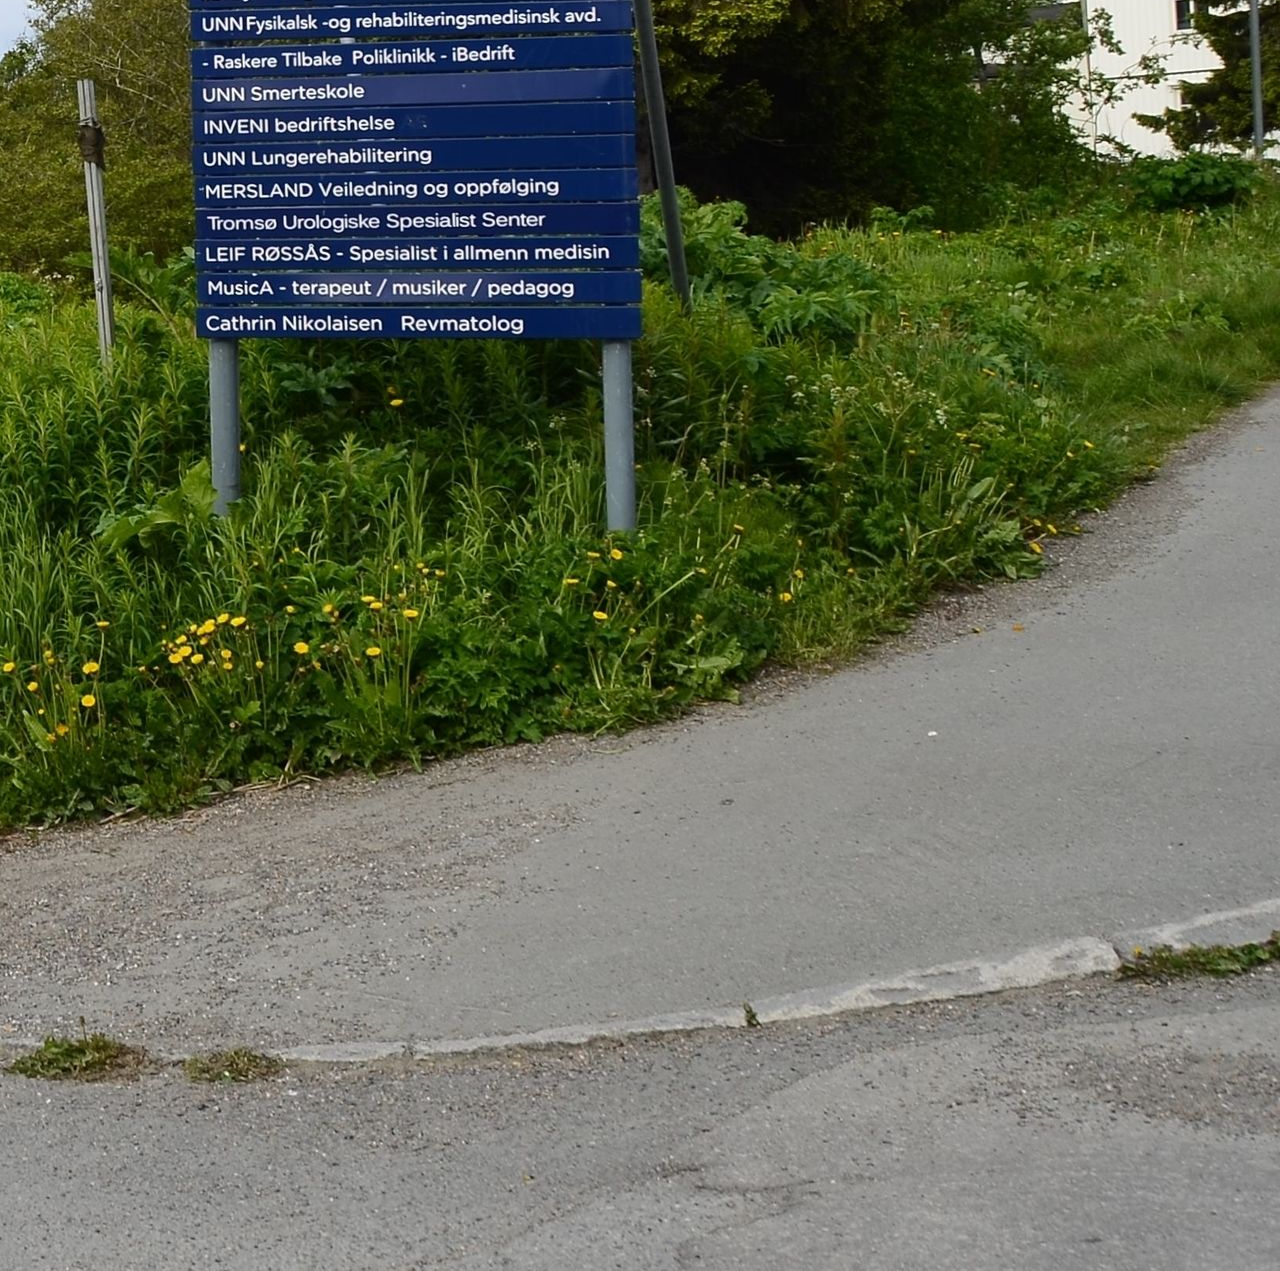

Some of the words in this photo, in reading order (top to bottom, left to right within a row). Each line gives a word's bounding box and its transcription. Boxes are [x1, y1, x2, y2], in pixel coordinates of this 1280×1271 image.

[203, 17, 243, 31] UNN
[247, 14, 317, 34] Fysikalsk
[323, 18, 350, 32] -og
[356, 8, 560, 29] rehabiliteringsmedisinsk
[565, 7, 601, 22] avd.
[214, 54, 277, 69] Raskere
[282, 51, 342, 66] Tilbake
[353, 48, 435, 64] Poliklinikk
[453, 45, 515, 61] iBedrift
[203, 87, 244, 102] UNN
[251, 84, 364, 101] Smerteskole
[204, 119, 268, 134] INVENI
[275, 116, 394, 132] bedriftshelse
[204, 152, 245, 166] UNN
[252, 148, 431, 167] Lungerehabilitering
[206, 183, 313, 198] MERSLAND
[319, 181, 417, 198] Veiledning
[424, 184, 448, 197] og
[454, 179, 559, 197] oppfølging
[207, 216, 276, 230] Tromsø
[283, 214, 380, 232] Urologiske
[387, 213, 476, 231] Spesialist
[483, 212, 545, 227] Senter
[206, 247, 245, 261] LEIF
[252, 244, 330, 261] RØSSÅS
[350, 246, 437, 263] Spesialist
[444, 246, 447, 260] i
[454, 245, 528, 260] allmenn
[535, 244, 609, 259] medisin
[208, 281, 273, 295] MusicA
[292, 281, 371, 297] terapeut
[393, 280, 467, 295] musiker
[488, 280, 574, 297] pedagog
[206, 315, 275, 331] Cathrin
[283, 315, 382, 331] Nikolaisen
[402, 316, 523, 334] Revmatolog
